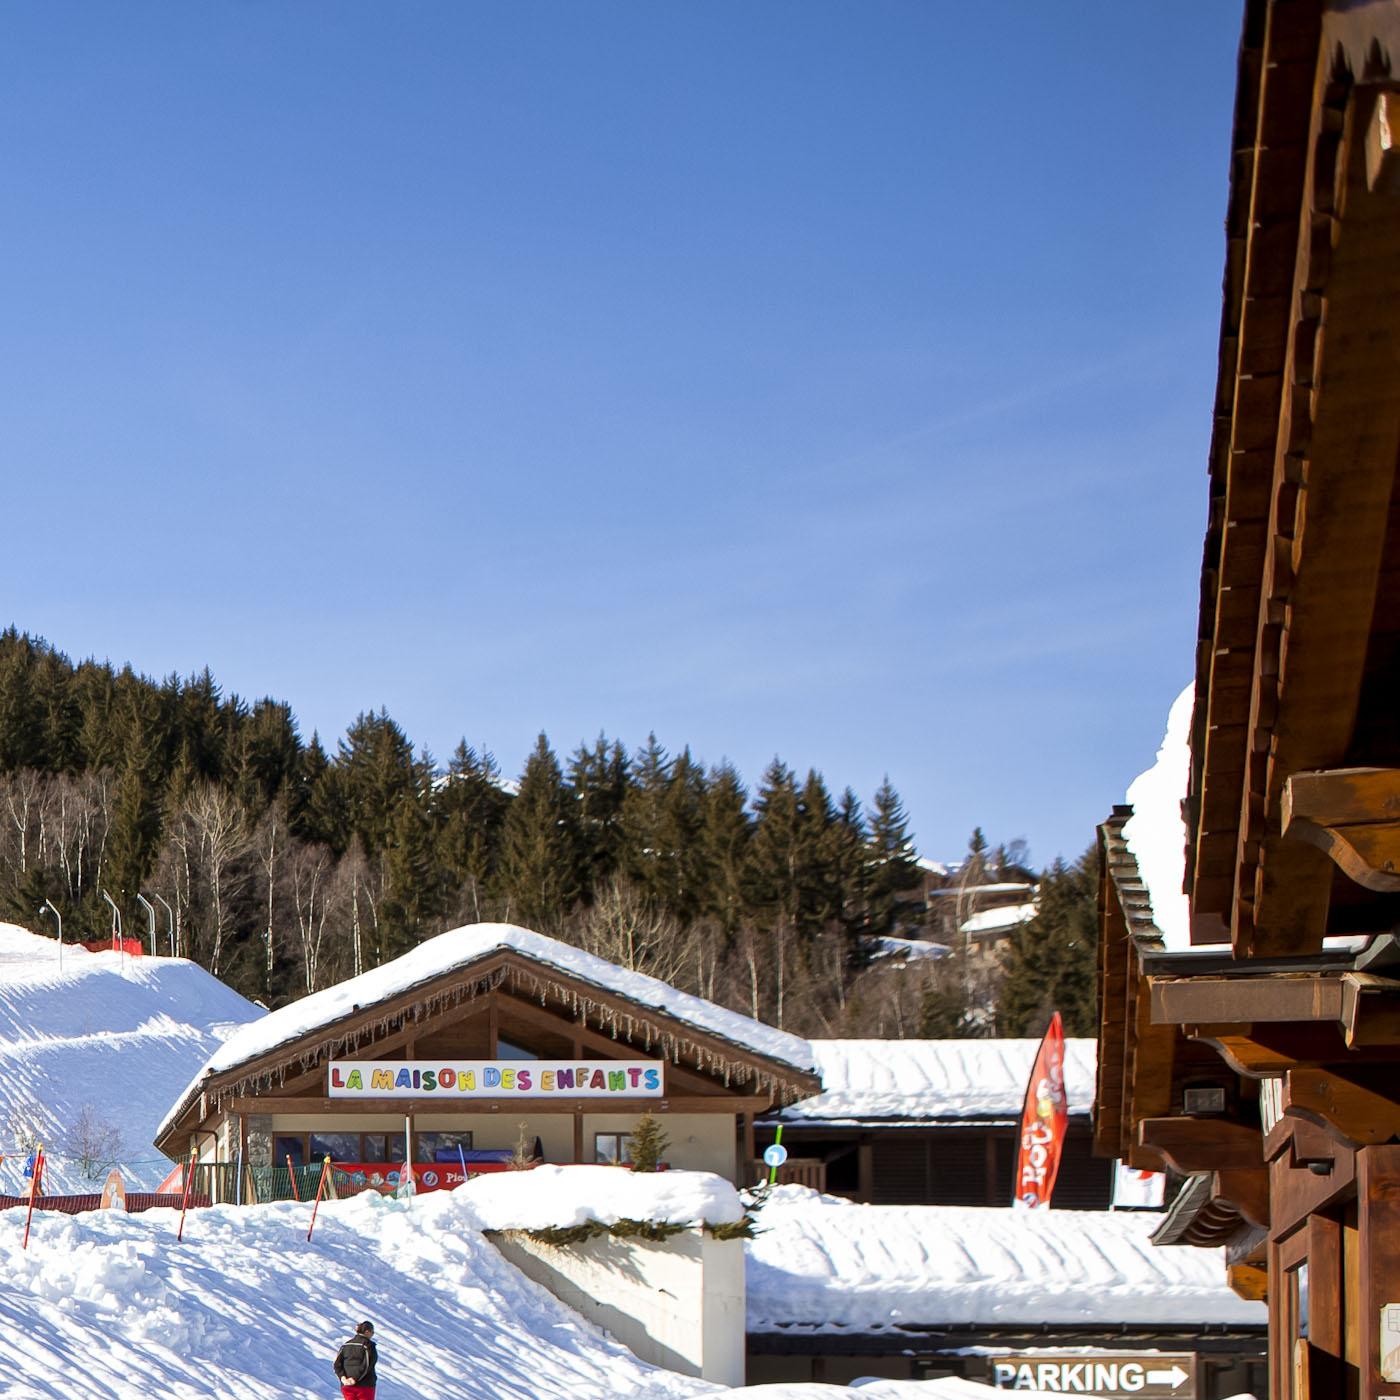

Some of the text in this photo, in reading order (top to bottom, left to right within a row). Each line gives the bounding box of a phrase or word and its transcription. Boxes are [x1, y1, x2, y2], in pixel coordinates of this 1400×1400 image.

[332, 1067, 661, 1092] LA MAISON DES ENFANTS
[994, 1363, 1145, 1392] PARKING
